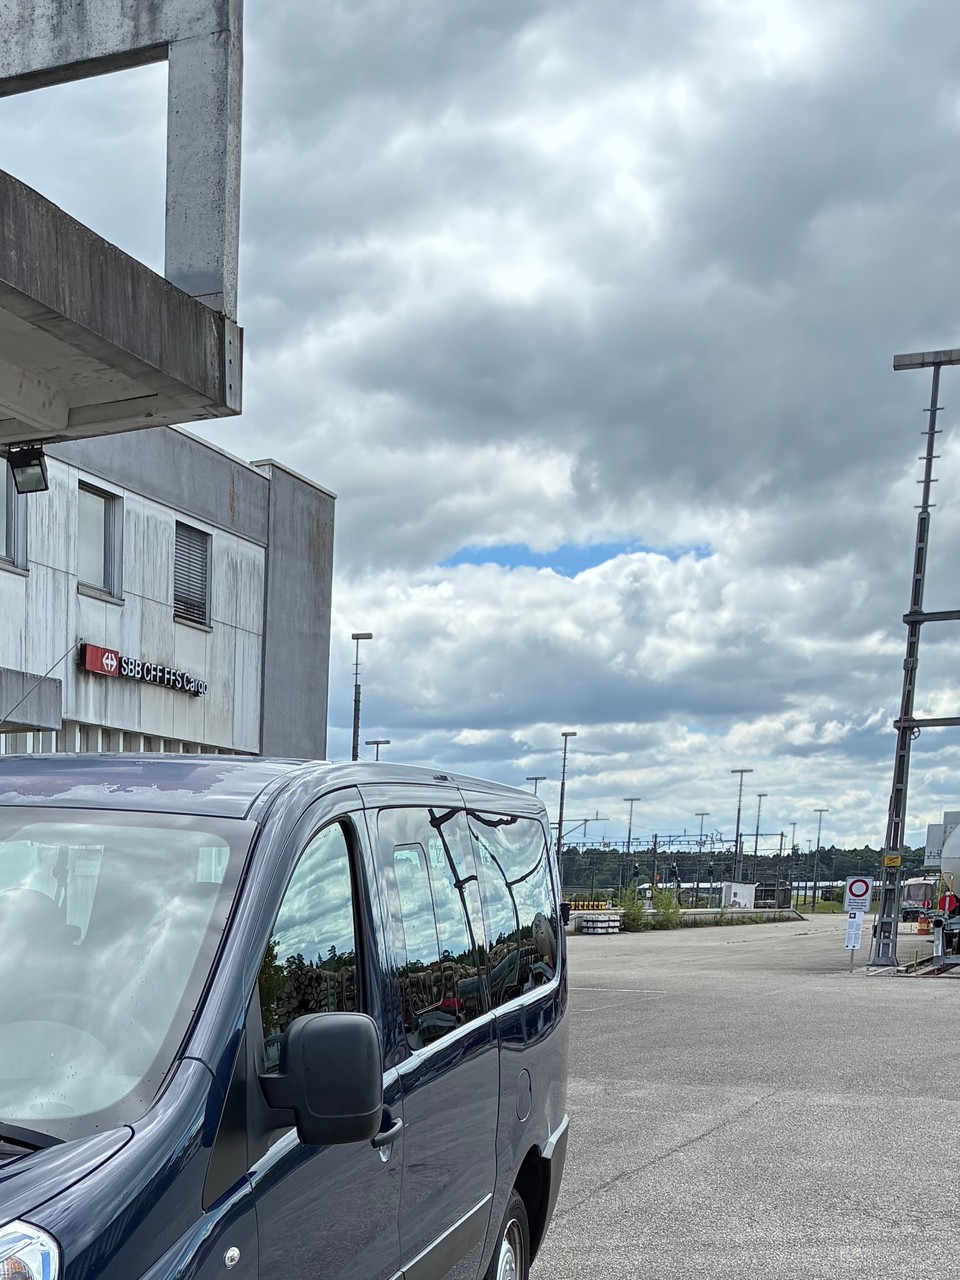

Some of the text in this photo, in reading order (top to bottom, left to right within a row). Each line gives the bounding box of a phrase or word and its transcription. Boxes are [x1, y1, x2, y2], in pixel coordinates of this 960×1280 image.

[121, 656, 209, 697] SBB CFF FFS Cargo
